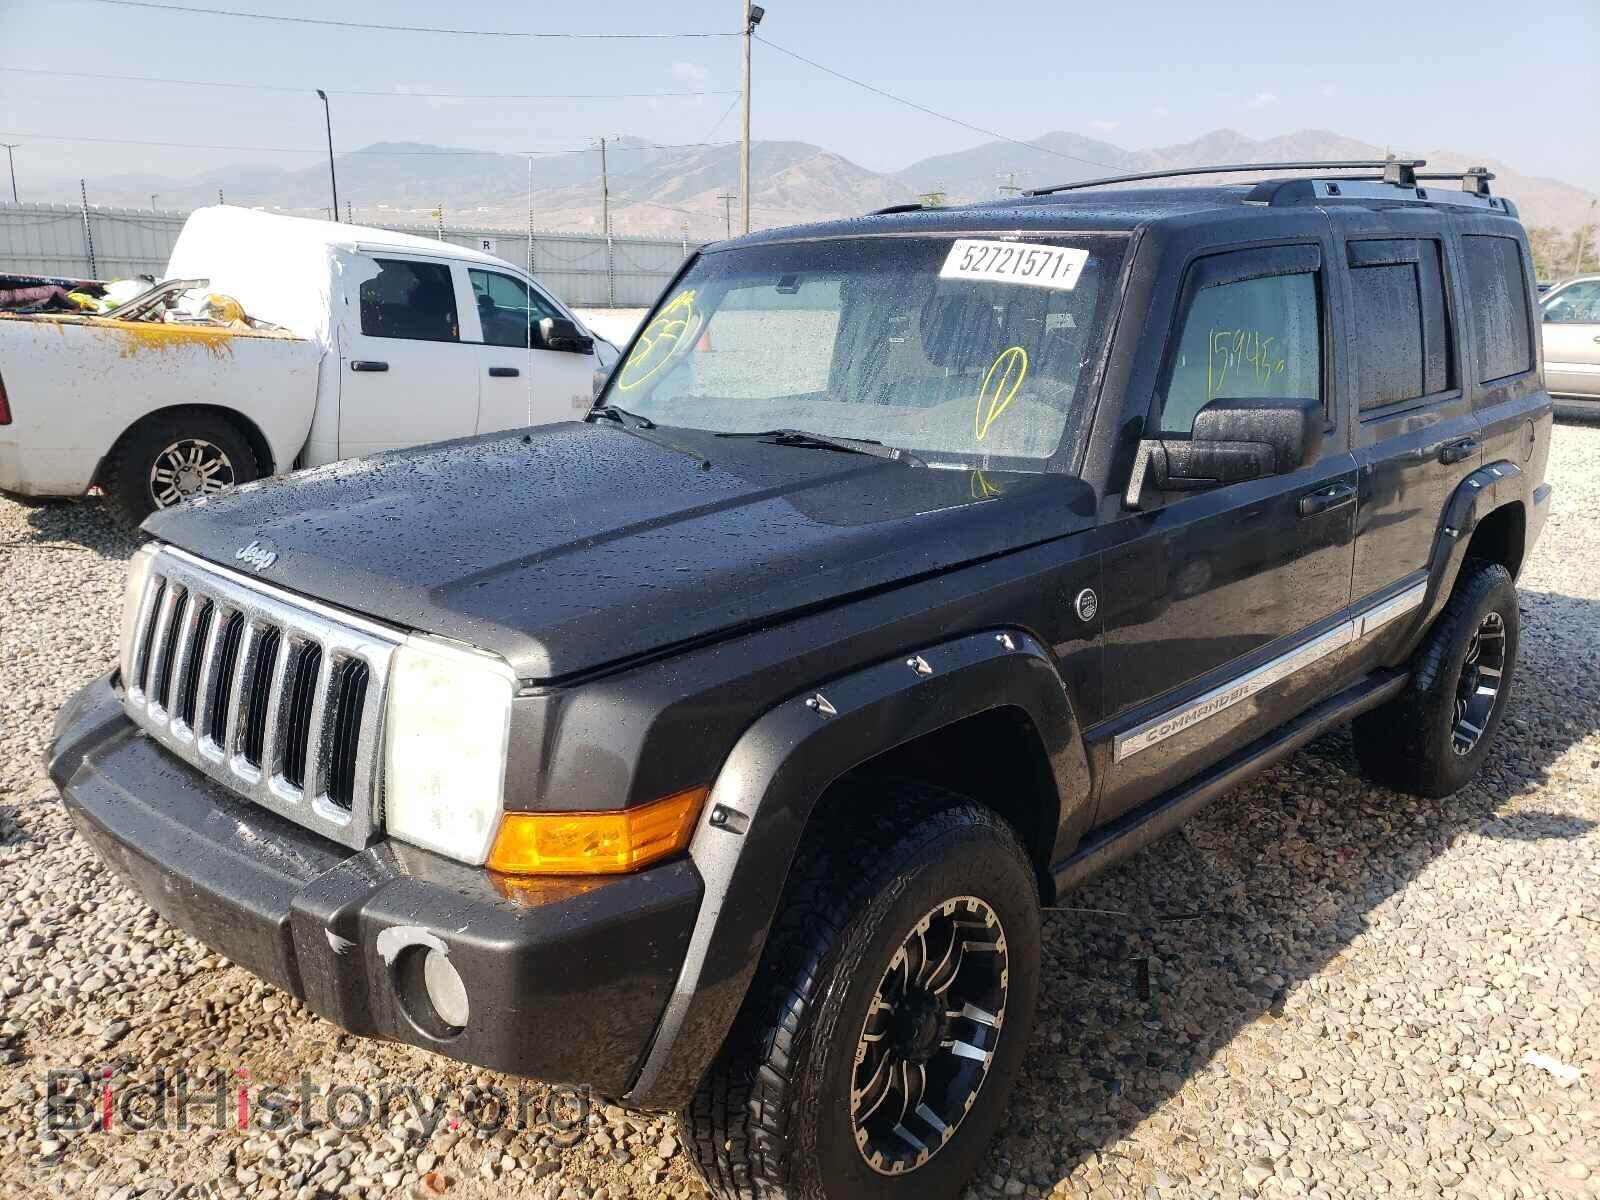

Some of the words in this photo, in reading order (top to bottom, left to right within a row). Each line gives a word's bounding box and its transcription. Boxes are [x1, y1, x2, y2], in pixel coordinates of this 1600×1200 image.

[483, 240, 491, 250] R
[959, 245, 1065, 279] 52721571
[235, 540, 278, 572] Jeep
[1144, 684, 1250, 742] COMMANDER
